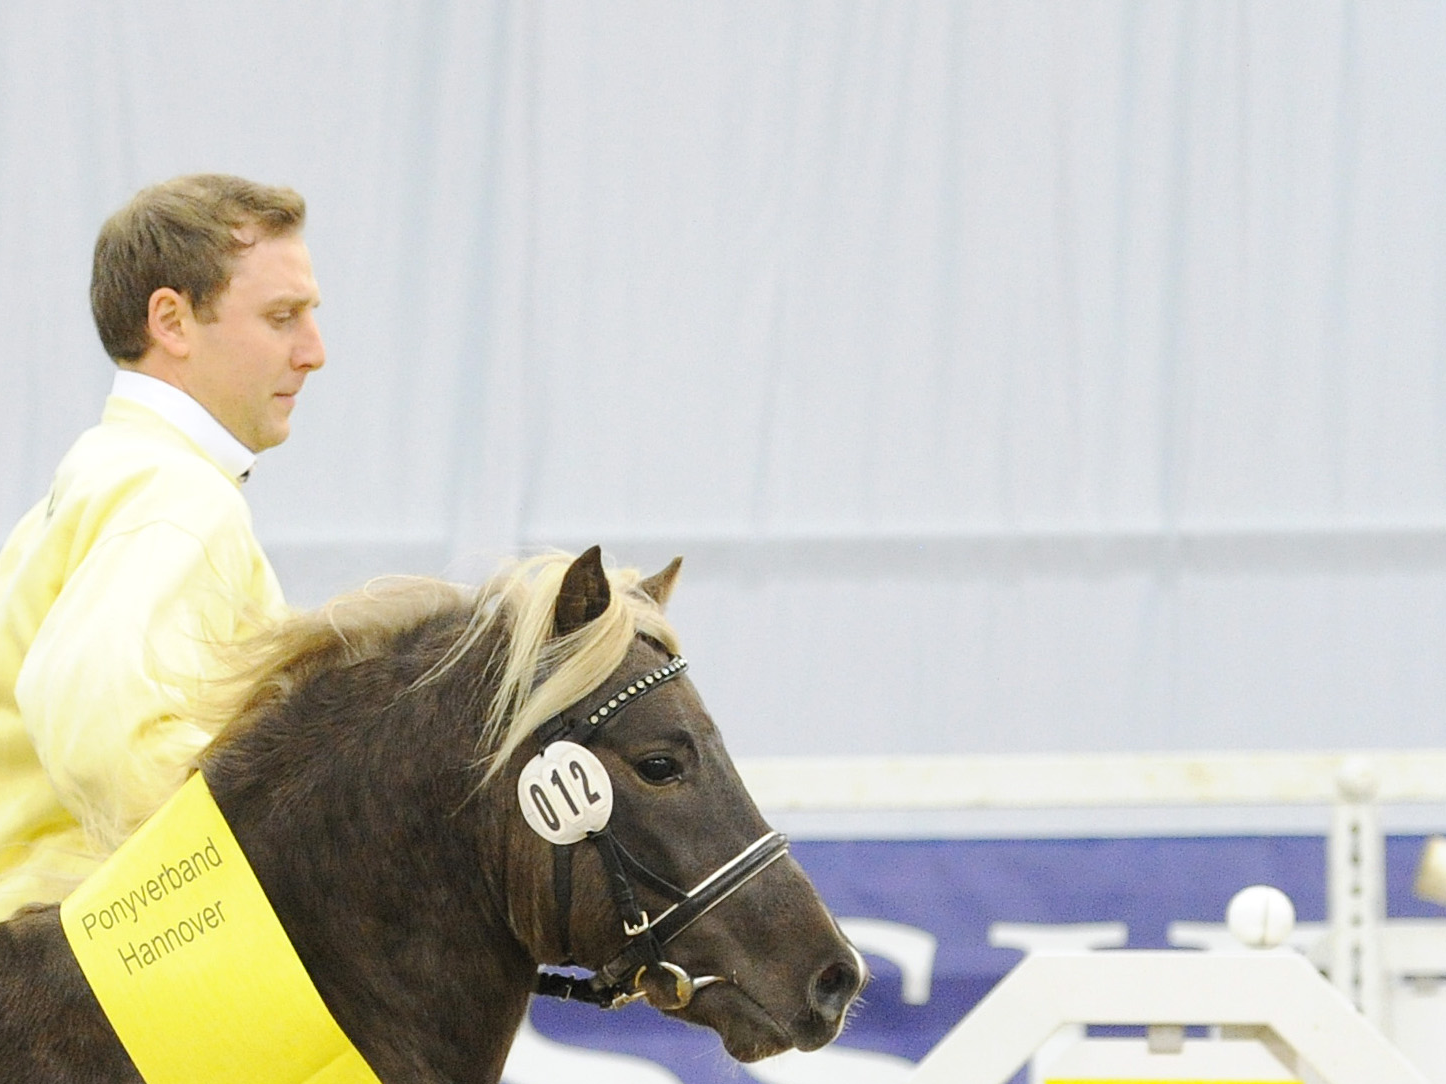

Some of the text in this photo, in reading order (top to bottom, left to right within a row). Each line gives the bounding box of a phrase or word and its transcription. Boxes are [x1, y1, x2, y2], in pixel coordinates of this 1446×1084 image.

[530, 760, 601, 831] 012
[81, 836, 223, 940] Ponyverband
[118, 900, 226, 975] Hannover
